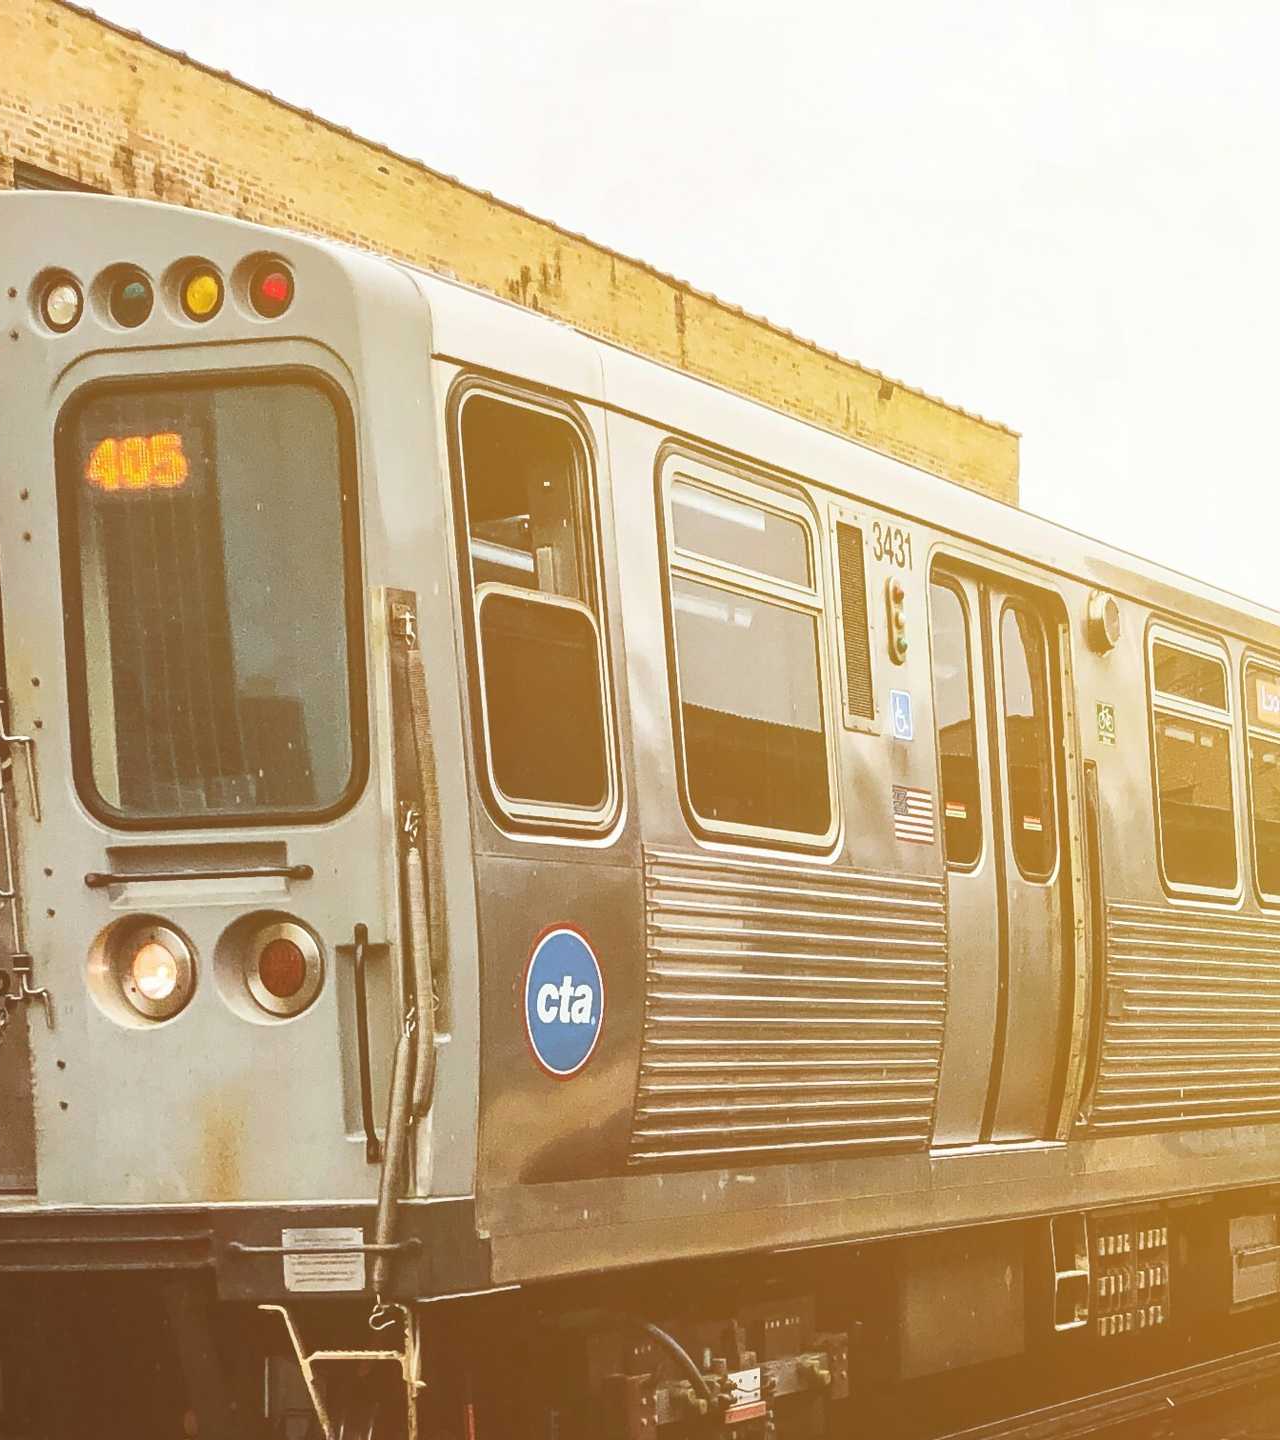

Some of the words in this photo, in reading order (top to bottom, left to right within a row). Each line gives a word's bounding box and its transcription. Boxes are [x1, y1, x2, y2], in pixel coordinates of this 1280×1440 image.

[86, 432, 189, 491] 405
[873, 521, 913, 571] 3431
[537, 976, 593, 1024] cta
